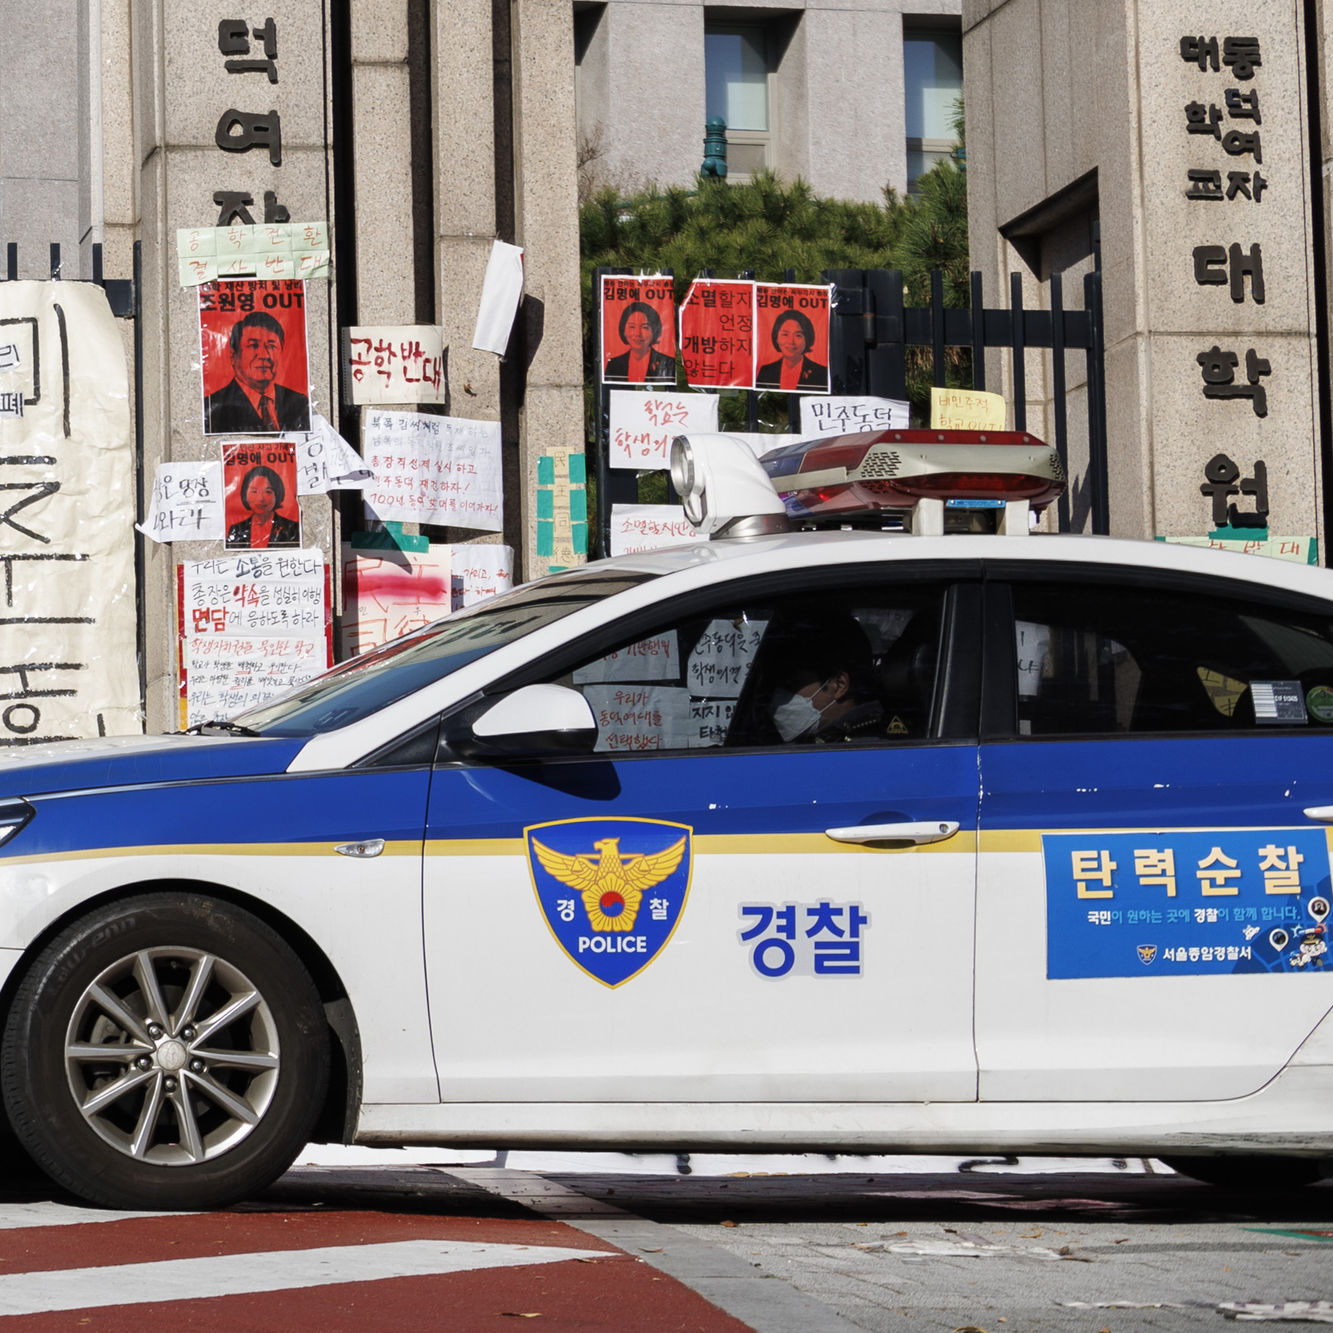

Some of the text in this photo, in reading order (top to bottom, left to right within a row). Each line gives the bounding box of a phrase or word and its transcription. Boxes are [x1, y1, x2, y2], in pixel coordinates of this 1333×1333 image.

[247, 280, 268, 290] 방치
[271, 280, 281, 290] 및
[603, 287, 674, 301] 김명애 OUT
[200, 291, 305, 312] 조원영 OUT
[756, 294, 828, 309] 김명애 OUT
[719, 313, 752, 332] 언정
[684, 336, 752, 356] 개방하지
[1191, 241, 1271, 529] 대학원
[267, 451, 296, 465] OUT
[276, 558, 322, 578] 원한다
[192, 582, 231, 606] 총장은
[233, 583, 270, 608] 약속을
[192, 606, 242, 633] 면담에
[613, 690, 648, 706] 우리가
[557, 898, 669, 922] 경 찰
[1088, 905, 1301, 925] 국민이 원하는 곳에 경찰이 함께 합니다.
[578, 936, 647, 953] POLICE
[740, 902, 868, 977] 경찰
